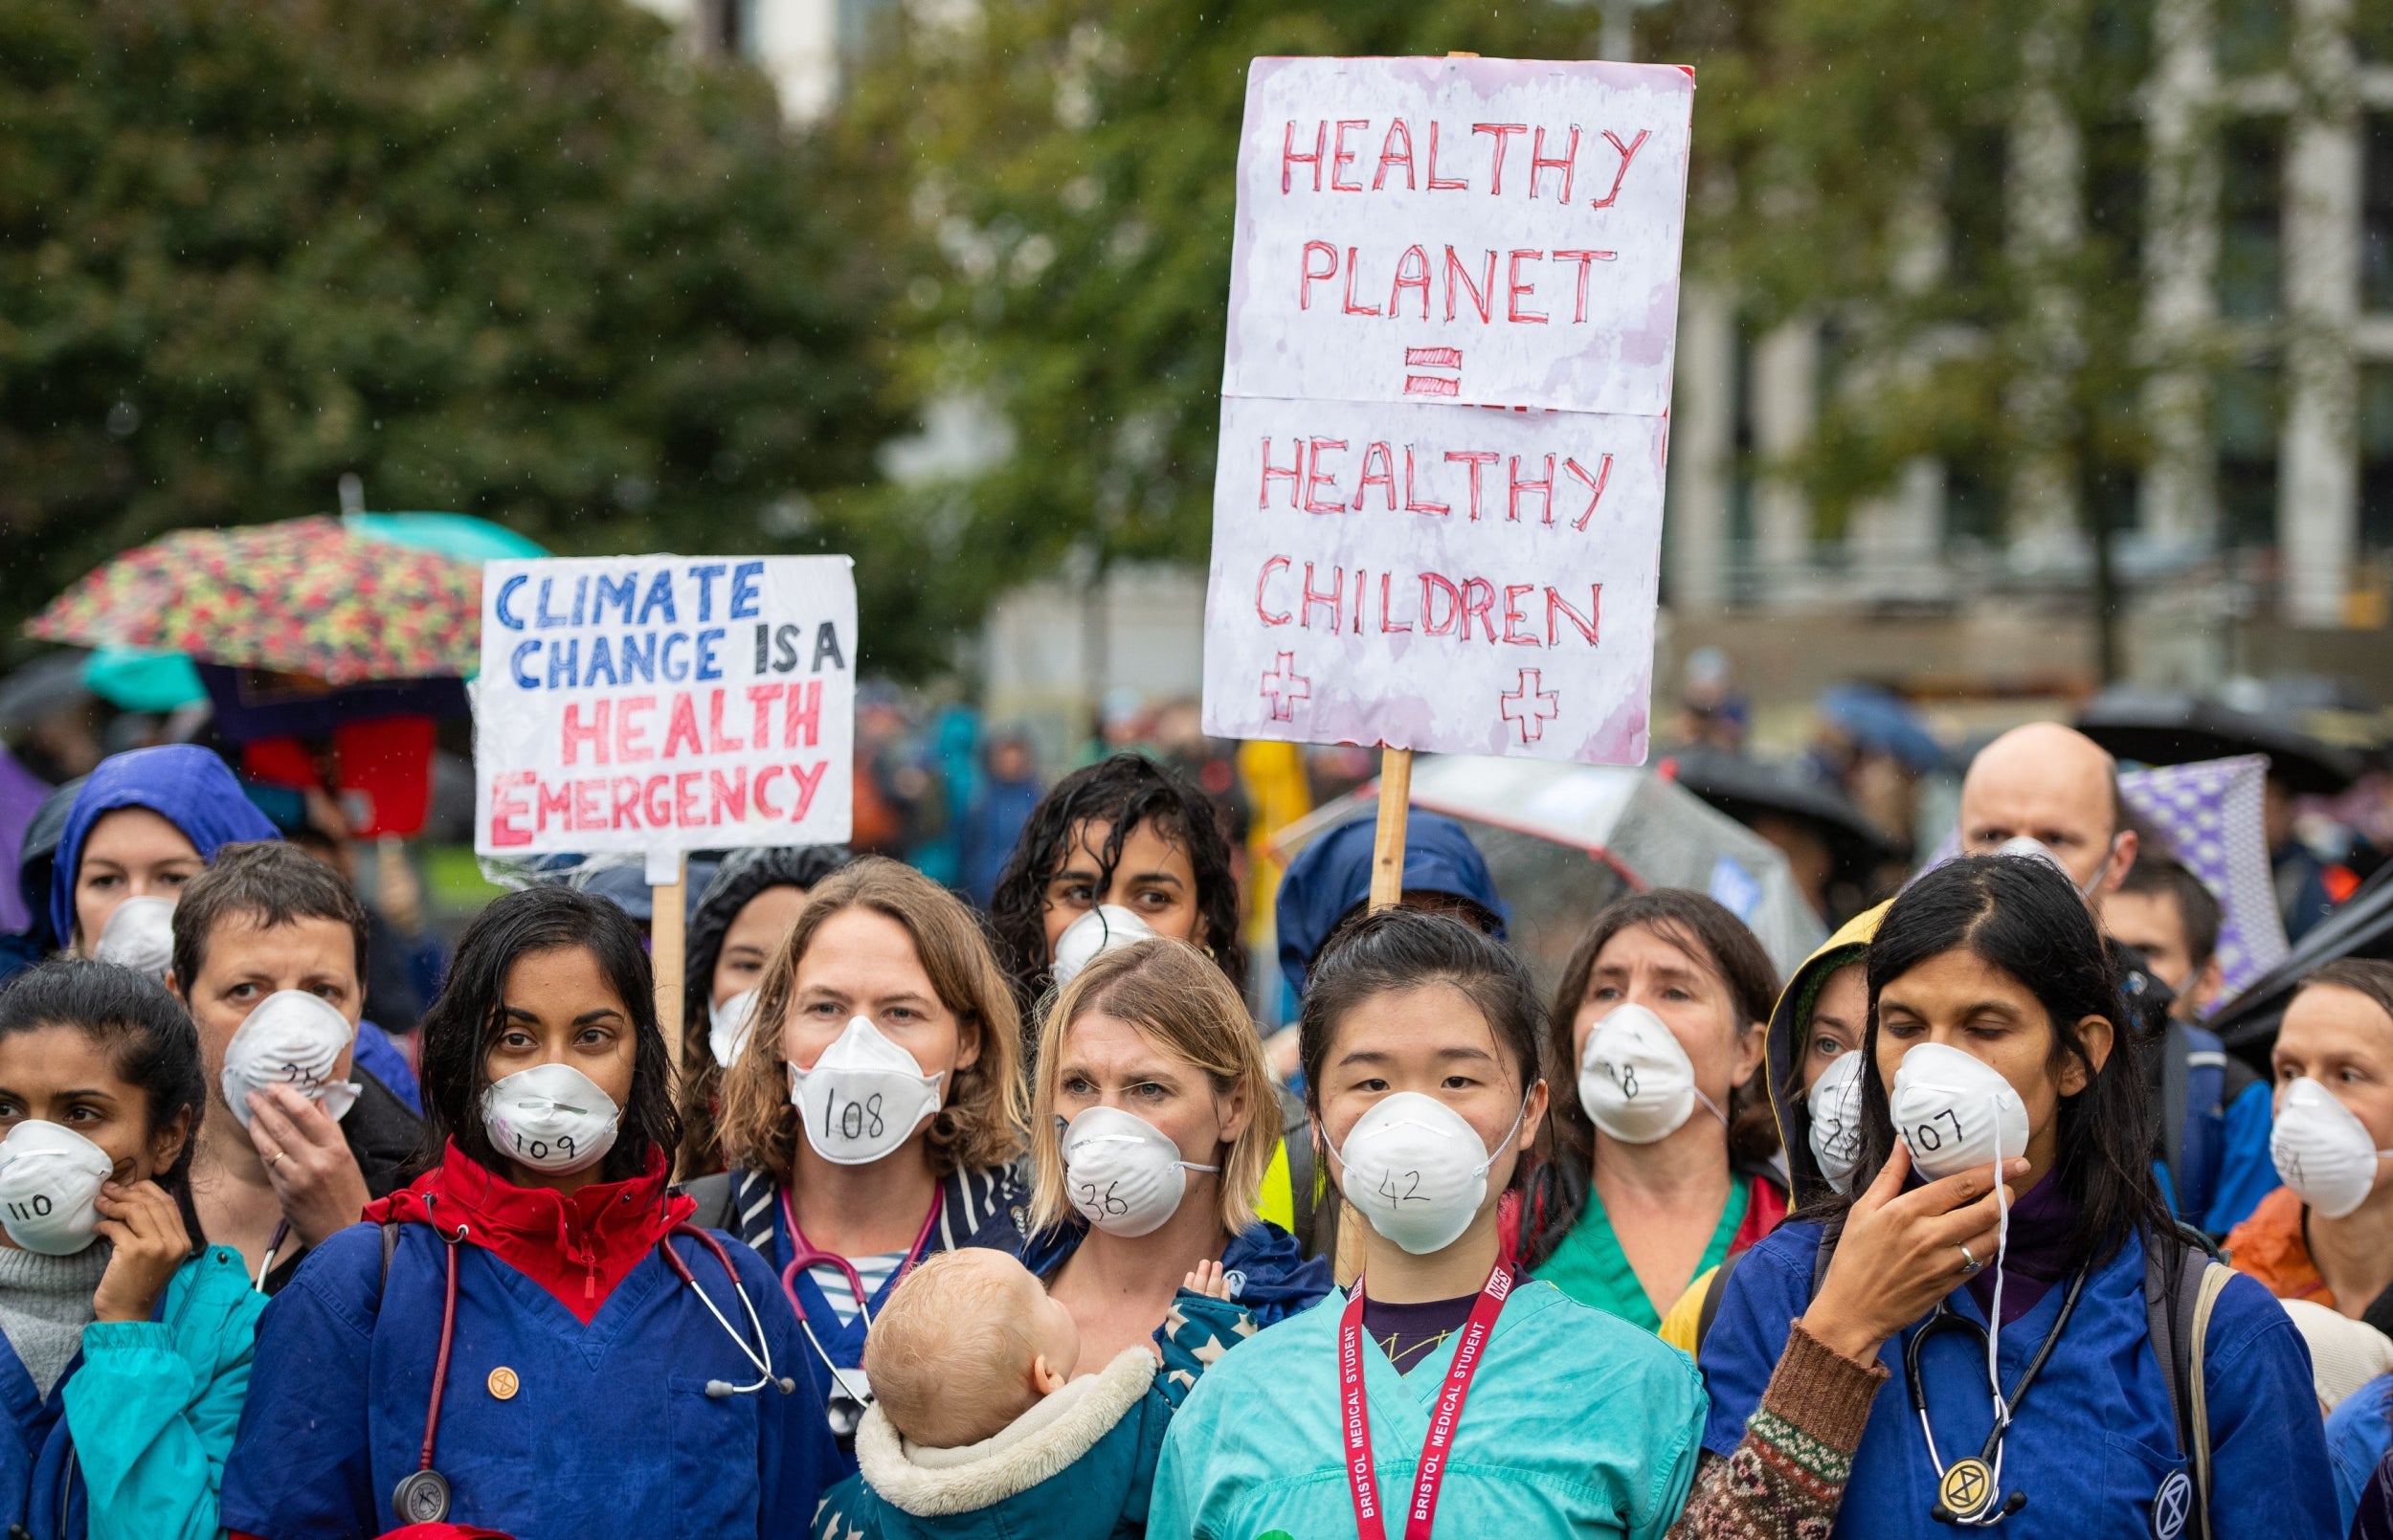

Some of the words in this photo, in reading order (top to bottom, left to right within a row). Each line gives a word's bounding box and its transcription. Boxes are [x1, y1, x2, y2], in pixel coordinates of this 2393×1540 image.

[1282, 118, 1652, 210] HEALTHY
[1300, 240, 1617, 324] PLANET
[1260, 435, 1613, 531] HEALTHY
[496, 562, 764, 630] CLIMATE
[1255, 554, 1602, 649] CHILDREN
[510, 628, 725, 690] CHANGE
[754, 623, 800, 674] IS
[812, 621, 844, 672] A
[562, 681, 822, 766] HEALTH
[490, 761, 829, 847] EMERGENCY
[517, 1133, 575, 1159] 109
[825, 1087, 883, 1139] 108
[1903, 1108, 1962, 1159] 107
[8, 1194, 52, 1221] 110
[1082, 1180, 1128, 1221] 36
[1378, 1169, 1431, 1210] 42
[1487, 1268, 1510, 1300] NHS
[1344, 1326, 1357, 1383] STUDENT
[1348, 1388, 1364, 1448] MEDICAL
[1415, 1454, 1440, 1520] BRISTOL
[1432, 1384, 1462, 1447] MEDICAL
[1454, 1322, 1486, 1379] STUDENT
[1354, 1453, 1375, 1519] BRISTOL
